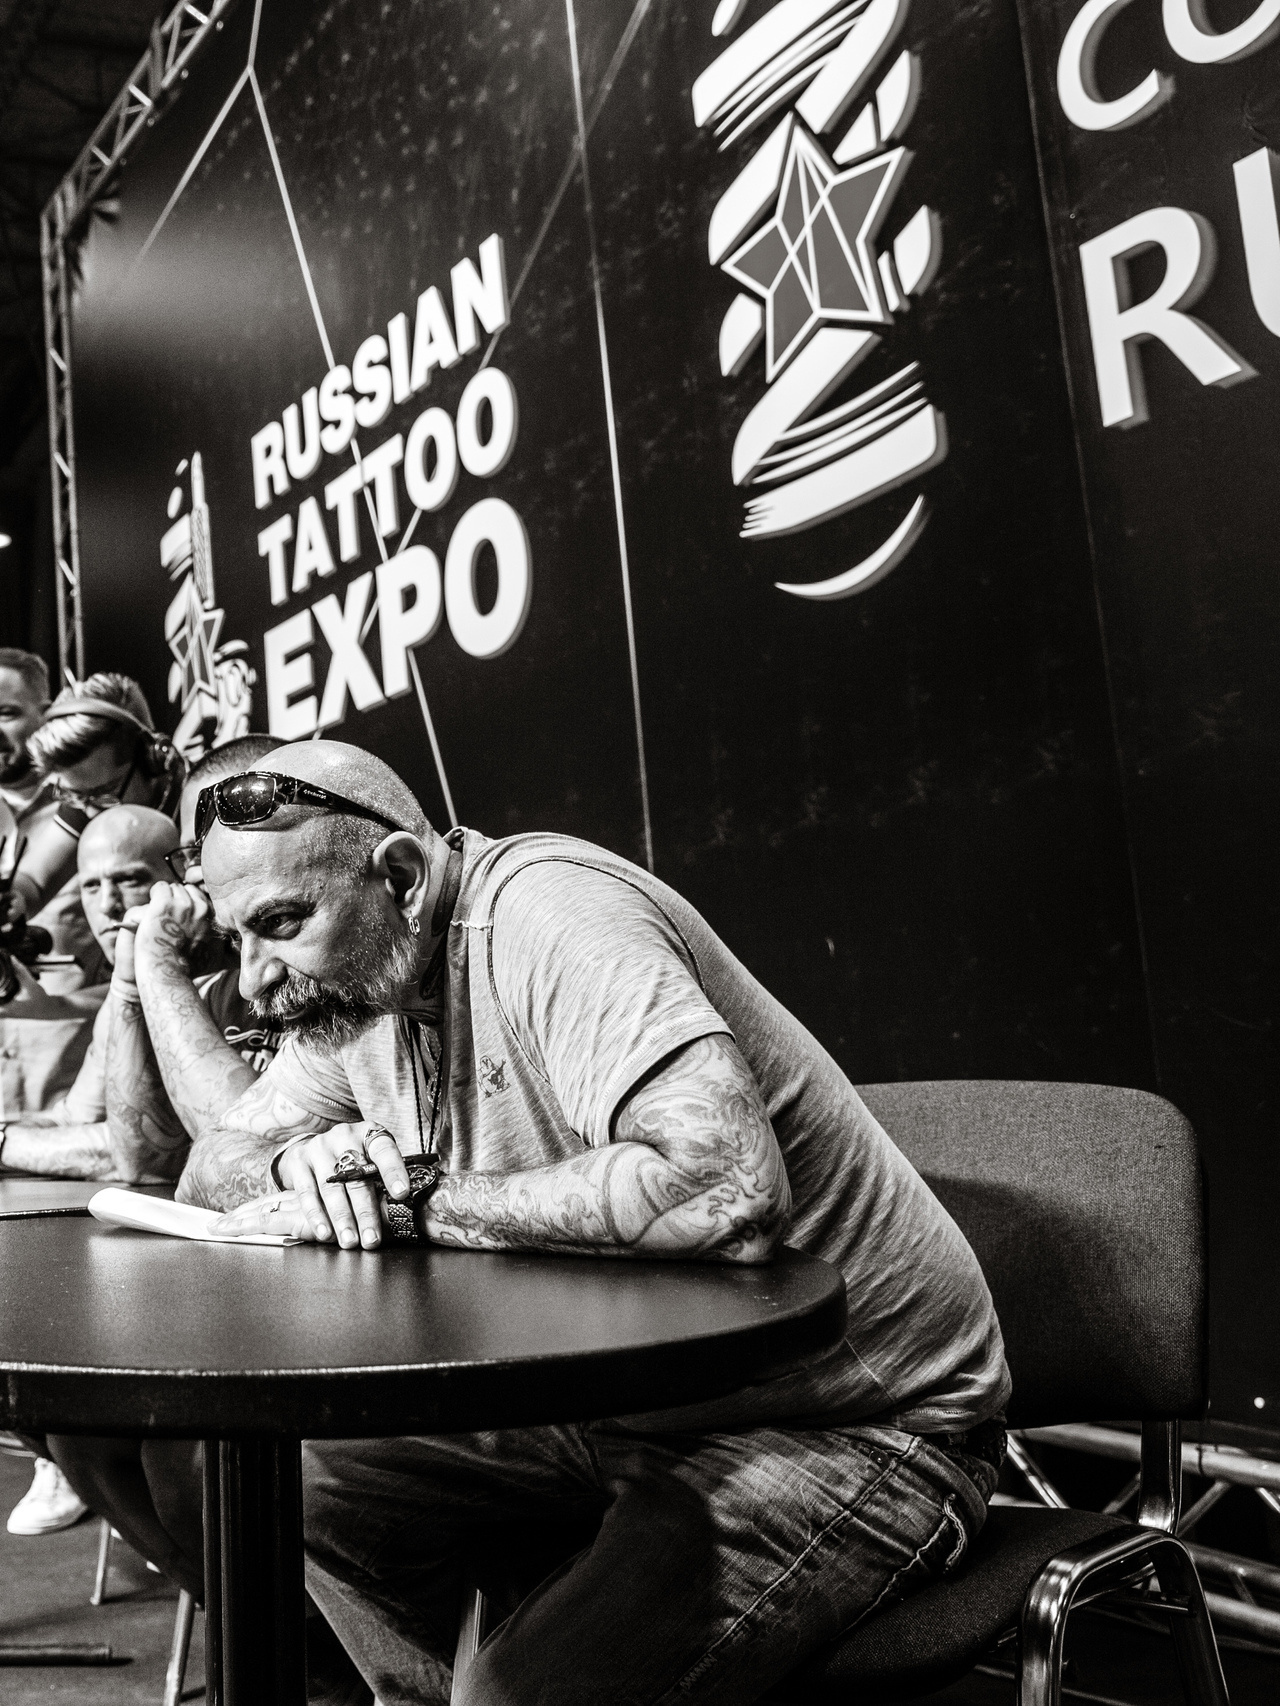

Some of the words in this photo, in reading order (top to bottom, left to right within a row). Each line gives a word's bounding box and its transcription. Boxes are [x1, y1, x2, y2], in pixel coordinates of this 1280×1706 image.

[251, 232, 511, 510] RUSSIAN
[258, 366, 517, 605] TATTOO
[264, 497, 533, 741] EXPO
